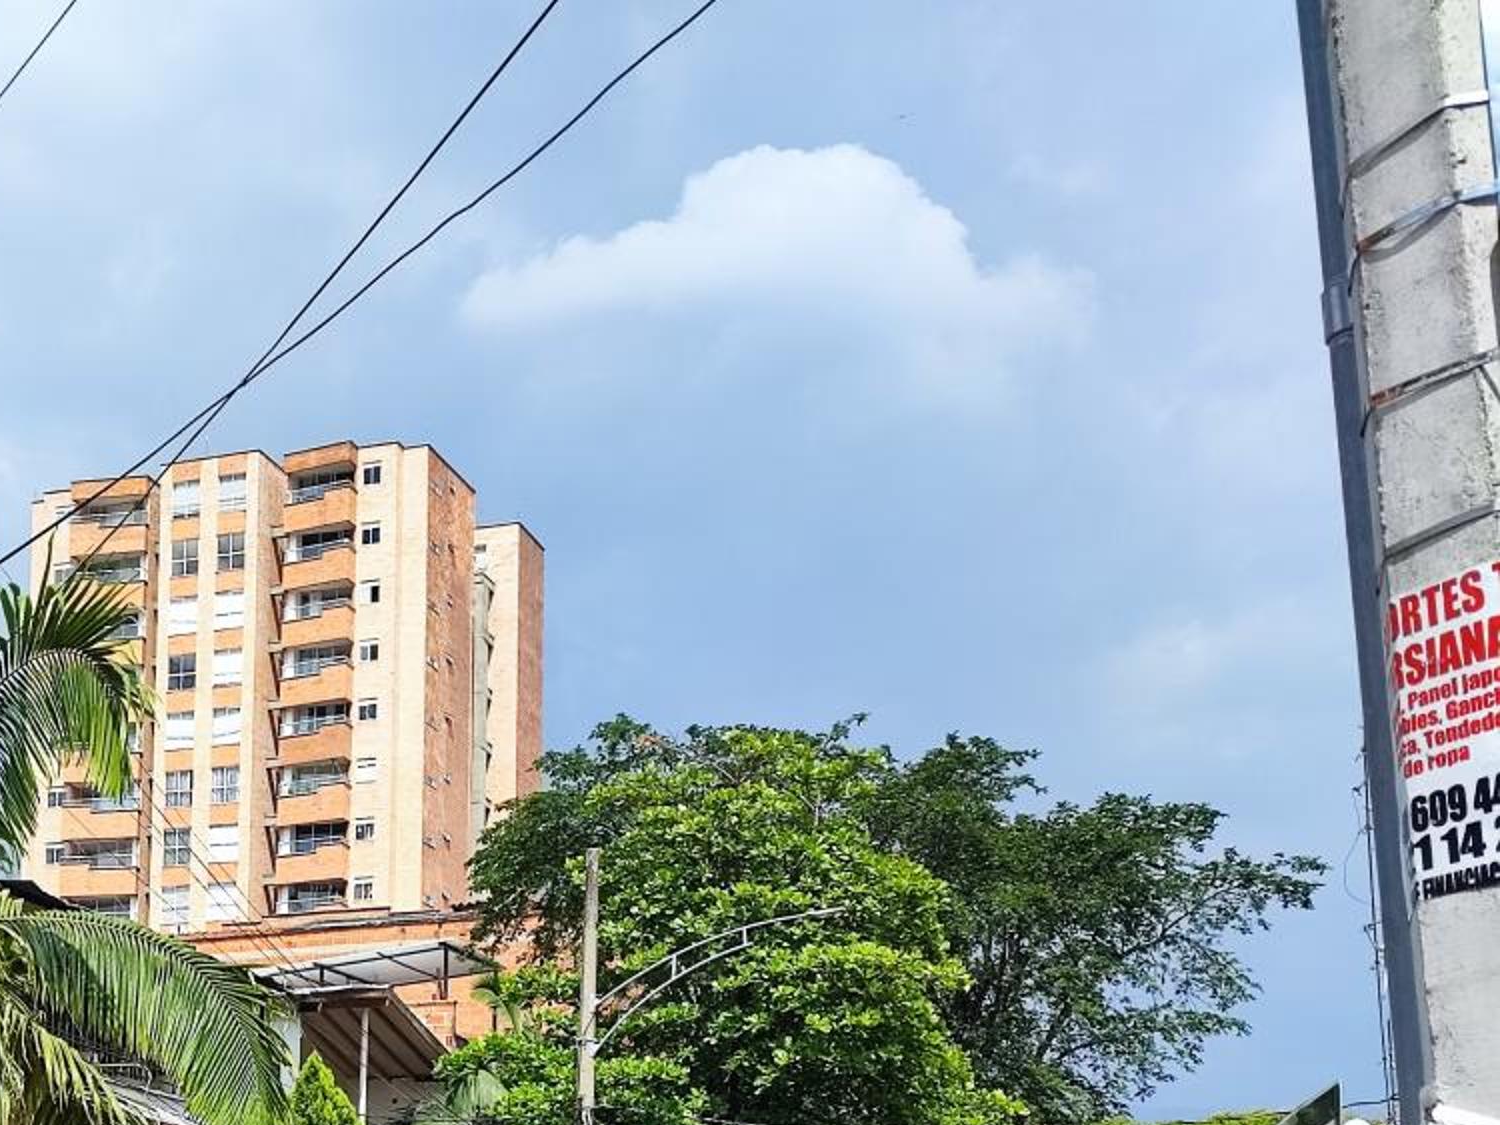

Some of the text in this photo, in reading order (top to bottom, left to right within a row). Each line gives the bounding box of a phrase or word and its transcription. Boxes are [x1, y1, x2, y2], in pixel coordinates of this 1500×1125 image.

[1408, 677, 1459, 711] Panel
[1427, 745, 1470, 771] ropa
[1411, 783, 1468, 833] 609
[1440, 820, 1487, 865] 14
